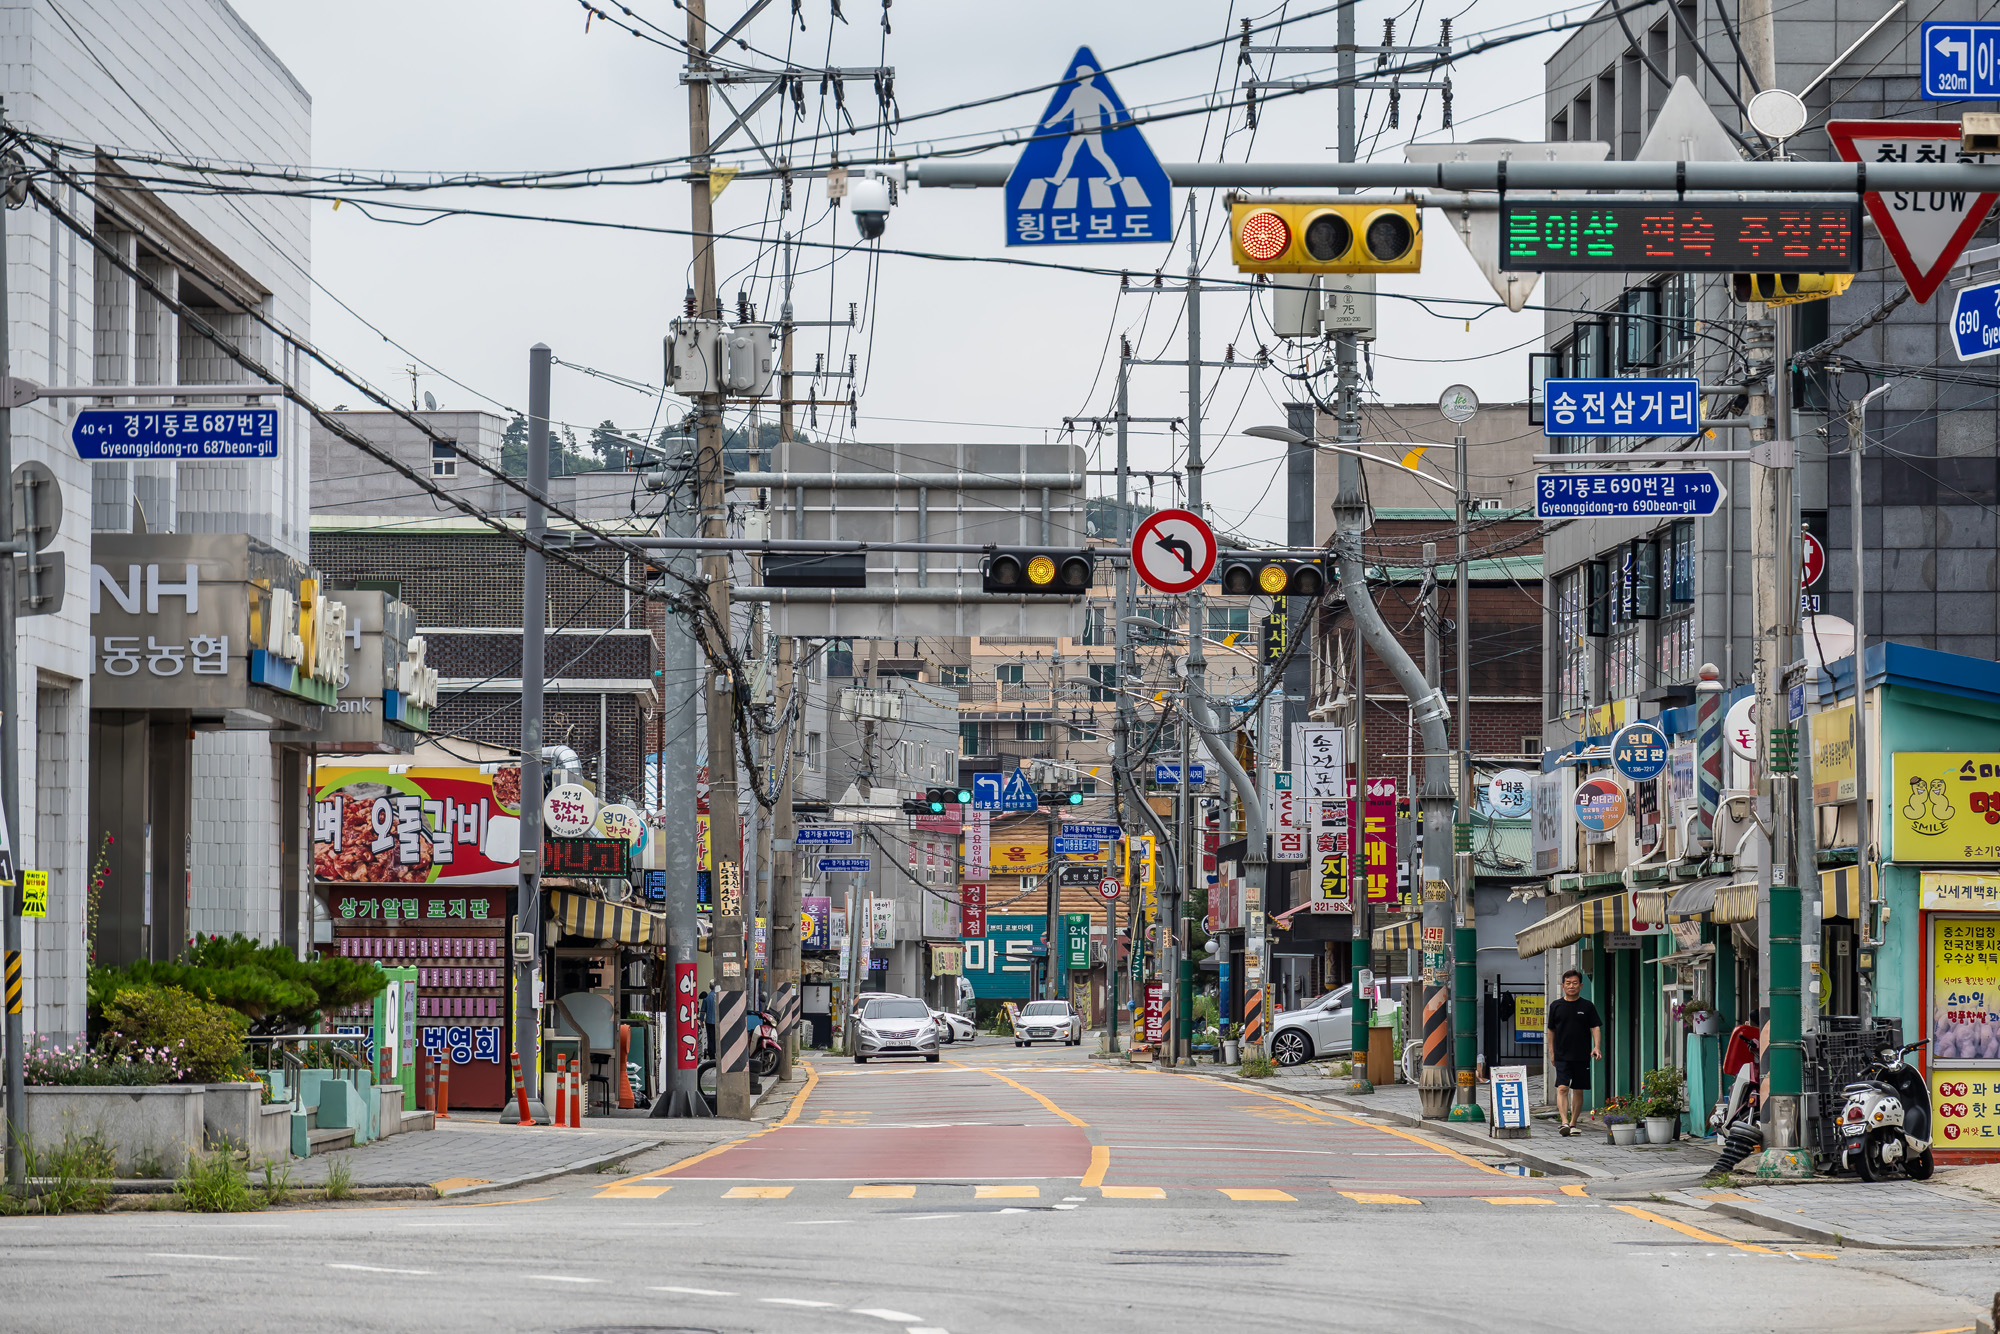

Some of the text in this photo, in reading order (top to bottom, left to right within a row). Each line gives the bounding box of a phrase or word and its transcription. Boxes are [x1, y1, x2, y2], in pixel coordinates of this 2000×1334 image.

[1938, 73, 1967, 90] 320m
[1016, 213, 1153, 241] 횡단보도
[1641, 211, 1716, 256] 연속
[1738, 211, 1852, 256] 주정차
[1342, 305, 1355, 315] 75
[1959, 309, 1980, 335] 690
[1551, 391, 1693, 425] 송전삼거리
[81, 425, 95, 436] 40
[124, 413, 274, 438] 경기동로687번길
[100, 440, 273, 457] Gyeonggidong-ro 687beon-gil
[1541, 476, 1676, 498] 경기동로690번길
[1700, 484, 1711, 494] 10
[1541, 499, 1697, 515] Gyeonggidong-ro 690beon-gil
[90, 563, 199, 614] NH
[91, 634, 229, 677] 동농협
[1628, 733, 1653, 745] 현대
[1618, 748, 1665, 762] 사진관
[1500, 780, 1524, 792] 대풍
[562, 791, 582, 801] 맛집
[1500, 793, 1524, 806] 수산
[1578, 793, 1622, 805] 감 인테리어
[975, 801, 1001, 810] 비보호
[555, 813, 590, 825] 아나고
[602, 811, 627, 827] 엄마
[1911, 820, 1948, 832] SMILE
[539, 842, 622, 871] 아나고
[1103, 883, 1117, 894] 50
[1936, 884, 2000, 900] 신세계백화
[338, 898, 490, 919] 상가알림 표지판
[966, 885, 982, 936] 정육점
[1943, 926, 1995, 938] 중소기업청
[964, 939, 1034, 974] 마트
[1070, 937, 1088, 966] 마트
[1943, 952, 1998, 964] 우수상 획득
[1943, 976, 1963, 986] 식어도
[1947, 991, 1984, 1007] 스마일
[679, 969, 697, 1062] 아나고
[1947, 1010, 1987, 1024] 명품찹쌀
[422, 1026, 500, 1064] 번영회
